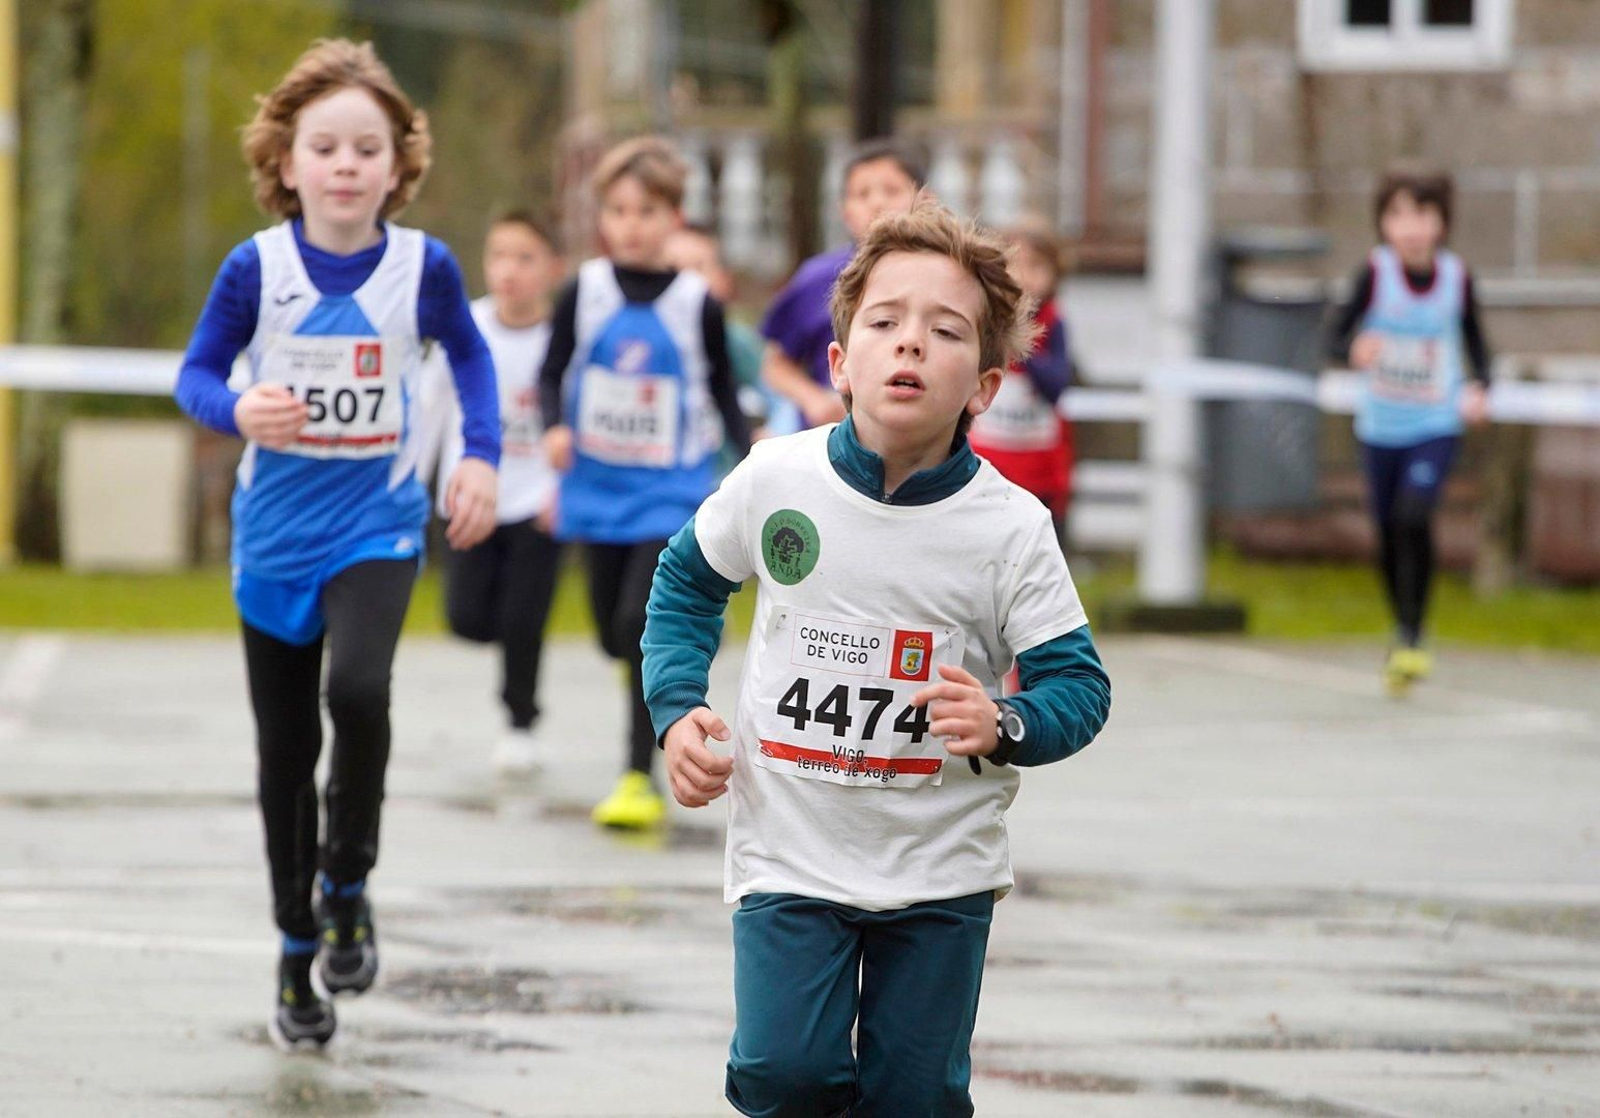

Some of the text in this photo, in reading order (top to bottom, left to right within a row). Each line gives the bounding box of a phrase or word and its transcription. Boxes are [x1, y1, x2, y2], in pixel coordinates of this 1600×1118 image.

[799, 626, 881, 650] CONCELLO
[806, 644, 869, 665] DE VIGO
[776, 677, 931, 744] 4474
[797, 754, 897, 783] terreo de xogo
